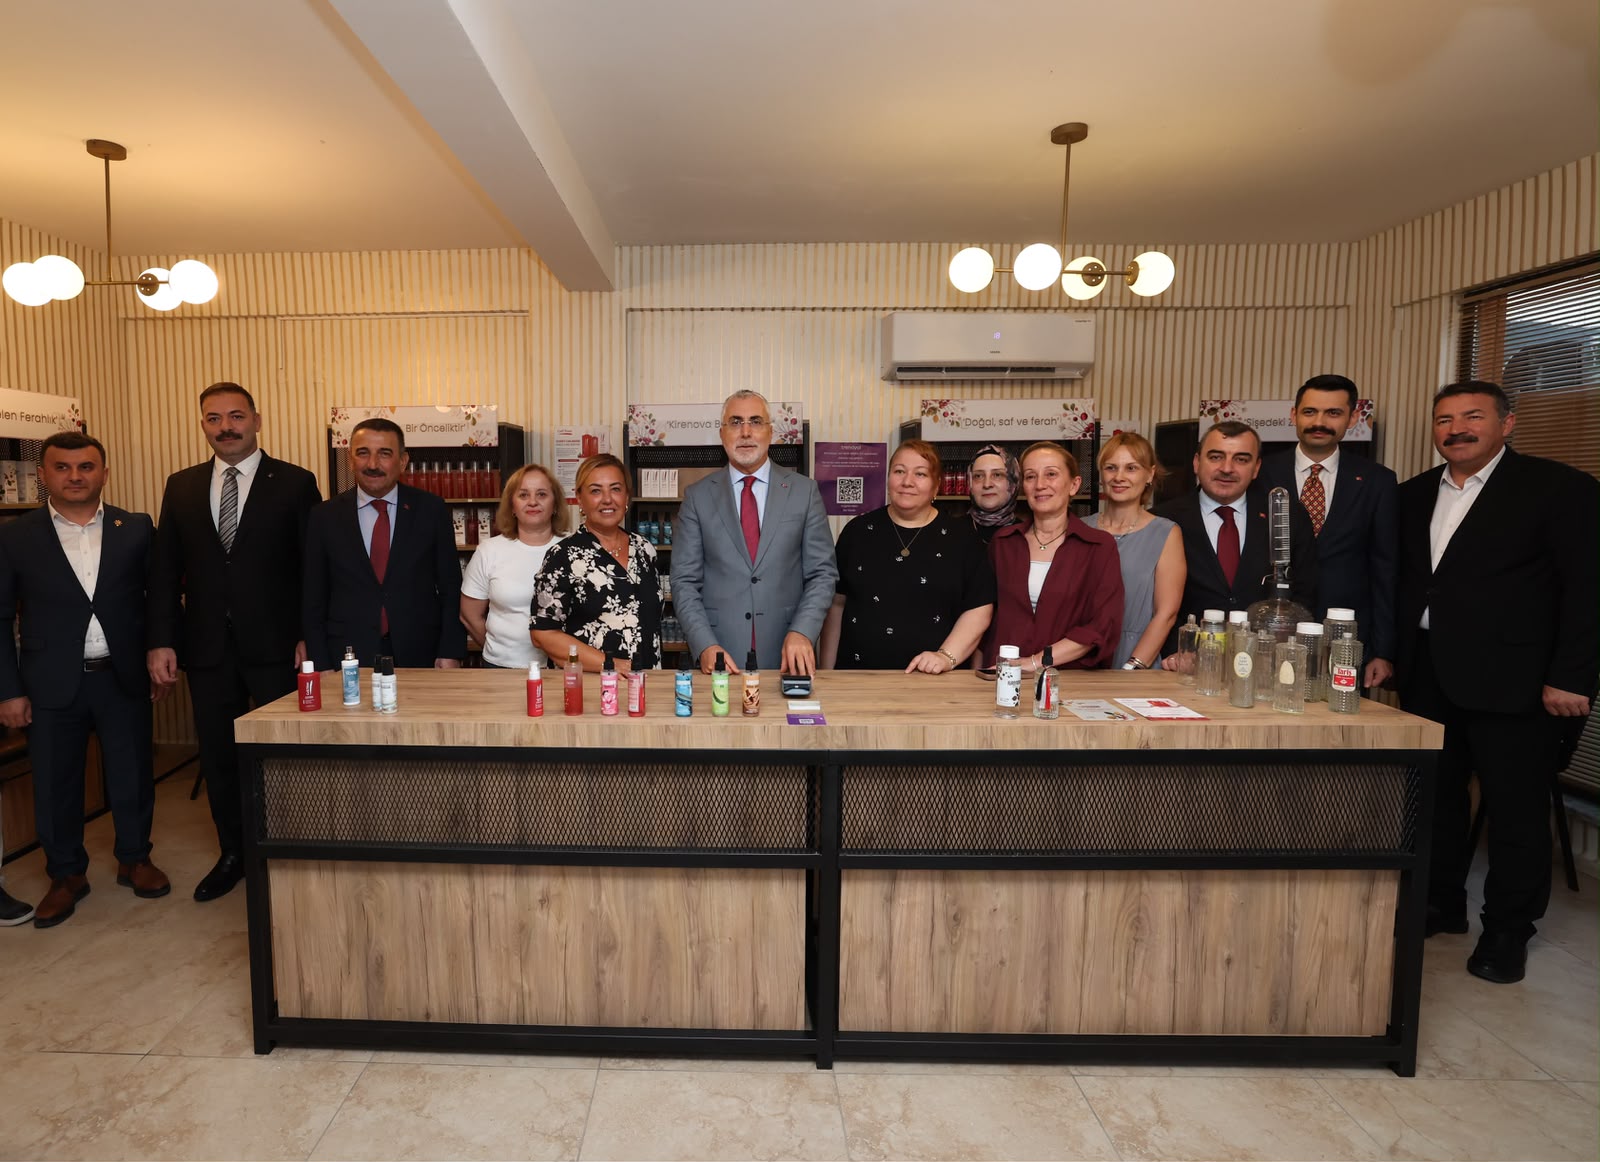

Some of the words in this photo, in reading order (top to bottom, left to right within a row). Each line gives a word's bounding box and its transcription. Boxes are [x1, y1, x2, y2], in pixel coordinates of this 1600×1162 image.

[998, 416, 1014, 426] saf
[1016, 418, 1029, 426] ve
[405, 424, 417, 433] Bir
